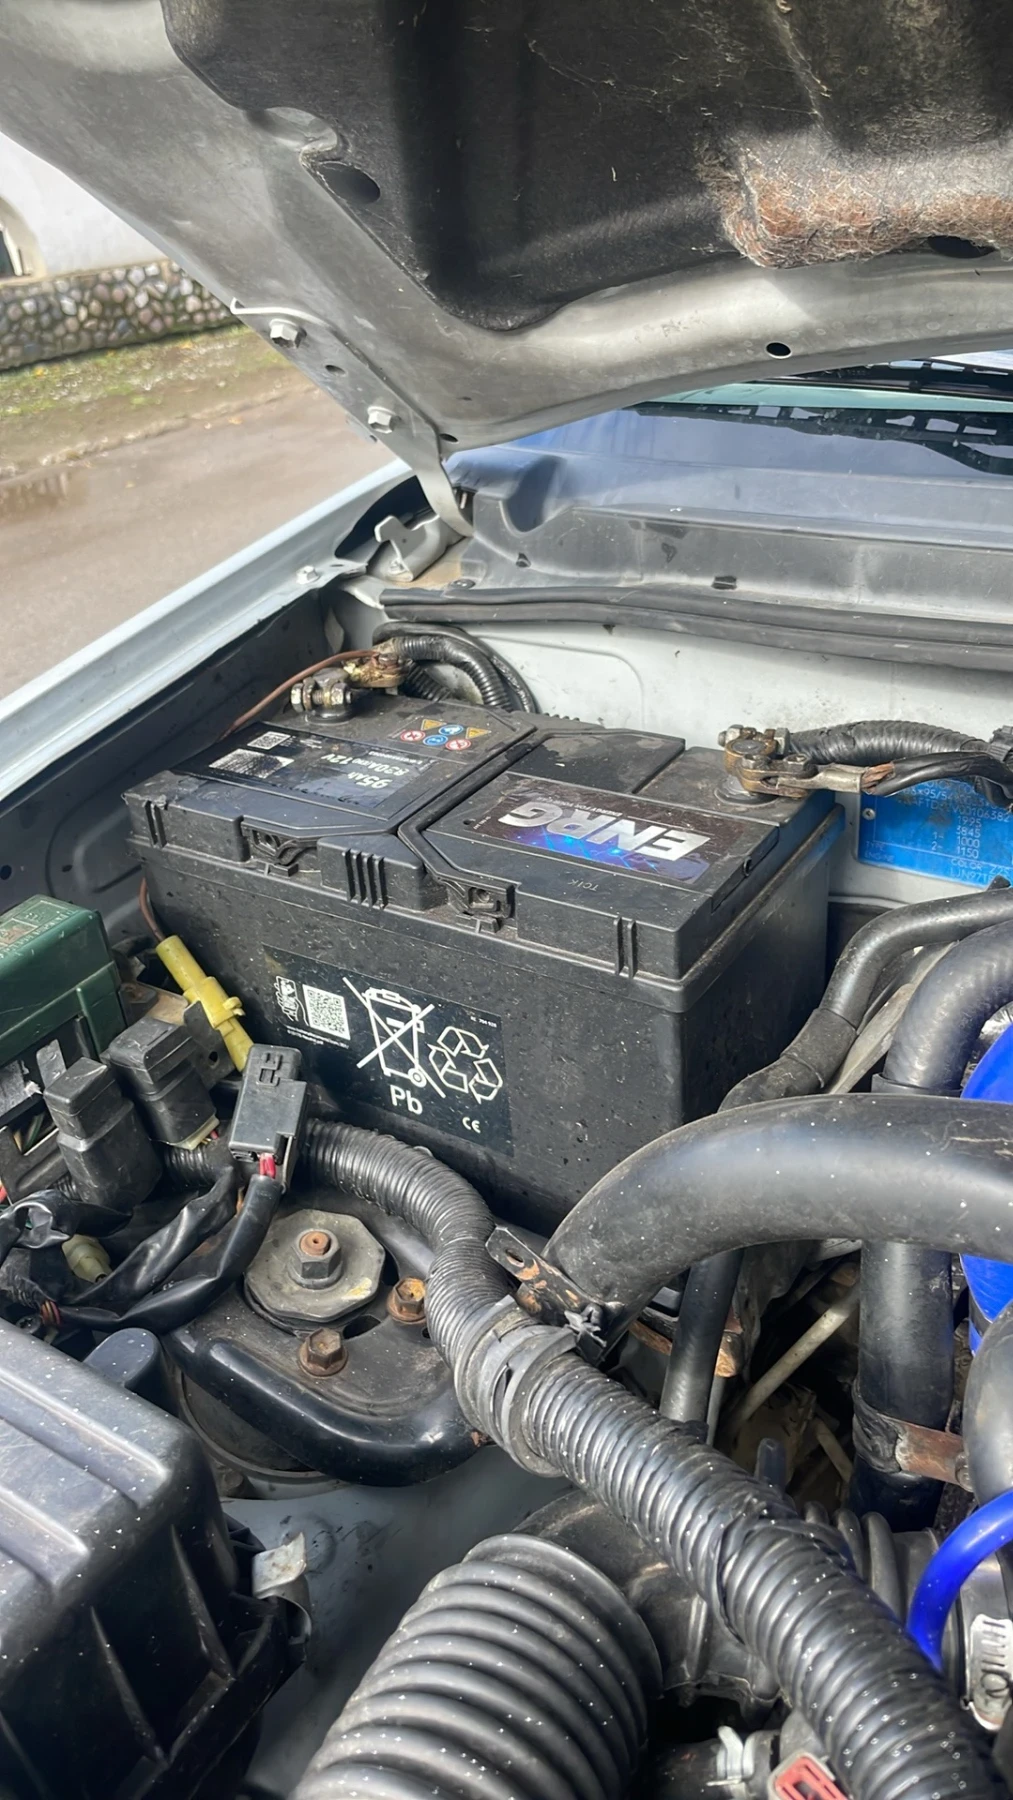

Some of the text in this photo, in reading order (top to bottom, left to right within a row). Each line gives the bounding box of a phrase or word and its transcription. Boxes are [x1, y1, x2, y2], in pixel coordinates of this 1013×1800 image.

[498, 801, 711, 862] ENRG
[957, 836, 980, 849] 1000
[956, 846, 979, 859] 1150
[390, 1084, 423, 1115] Pb
